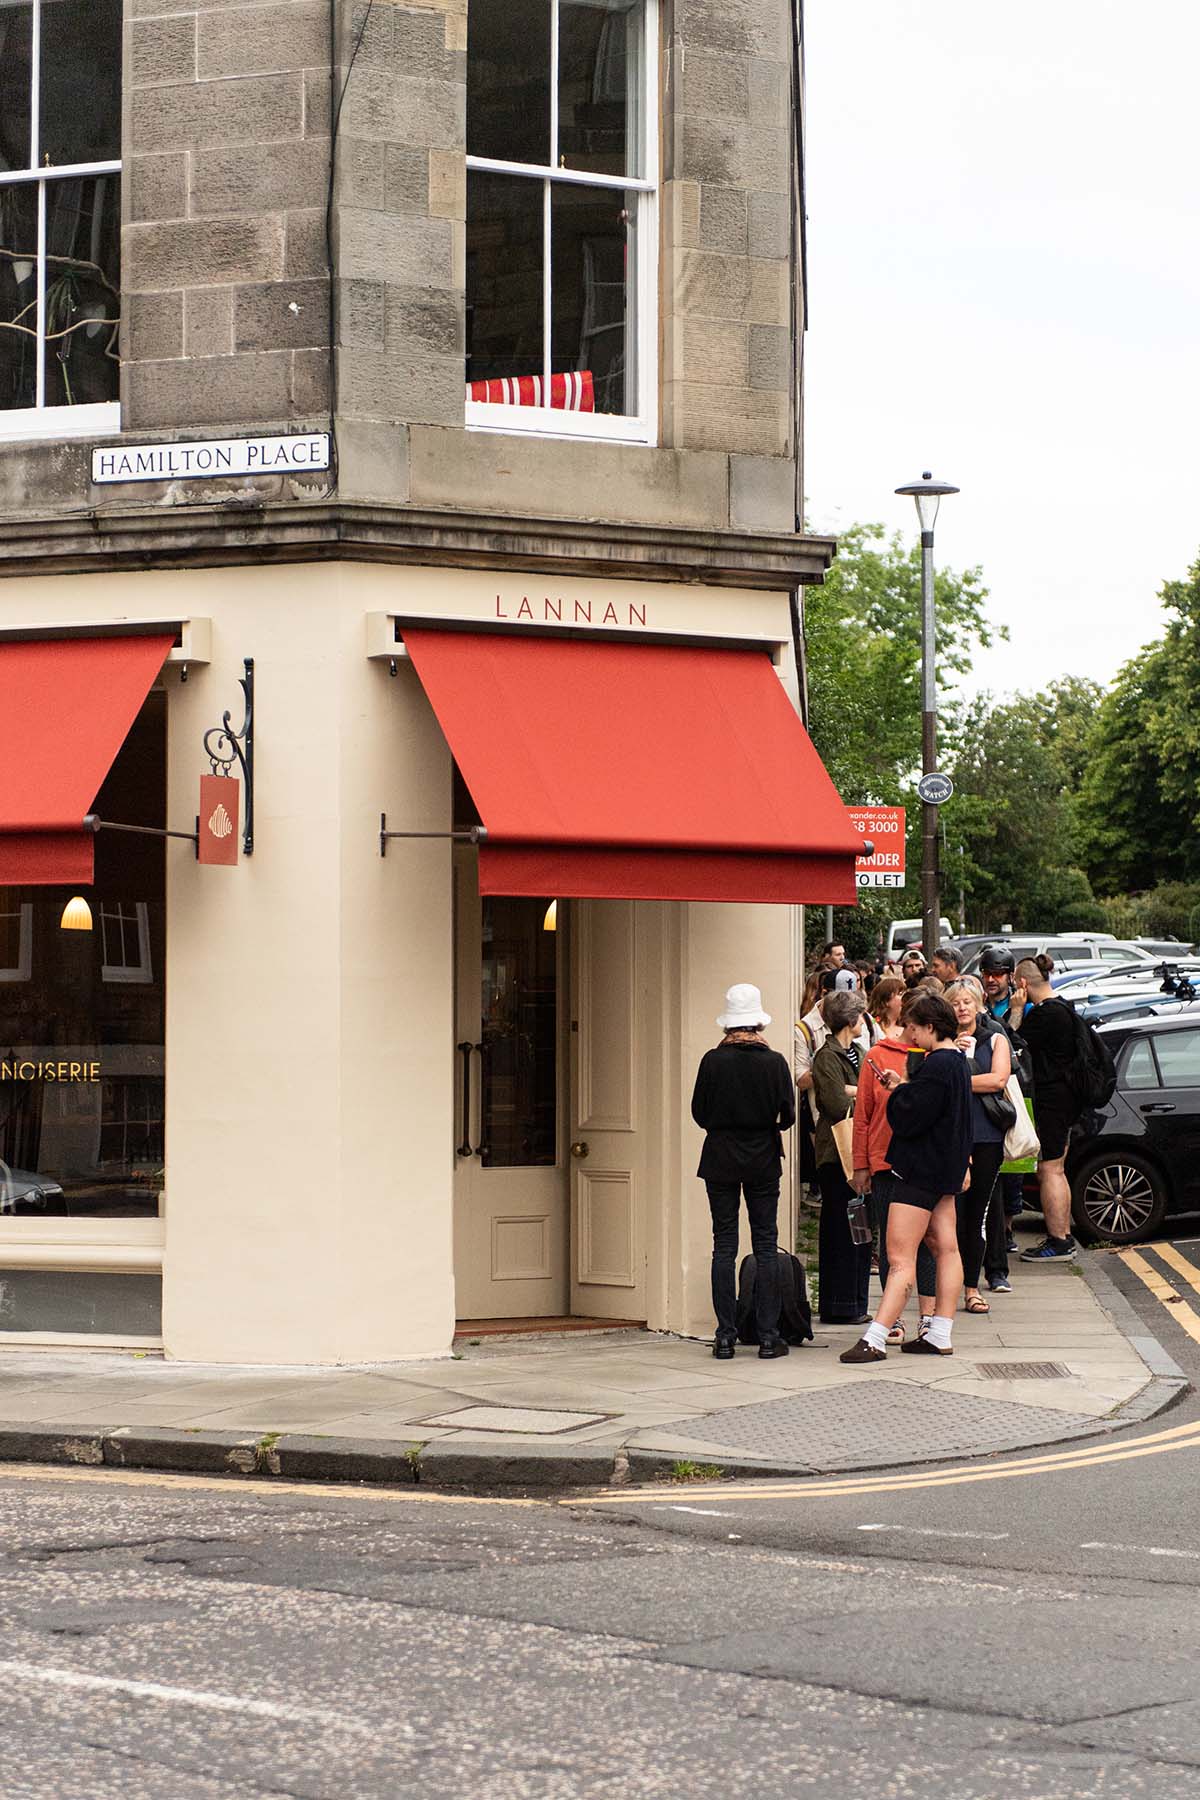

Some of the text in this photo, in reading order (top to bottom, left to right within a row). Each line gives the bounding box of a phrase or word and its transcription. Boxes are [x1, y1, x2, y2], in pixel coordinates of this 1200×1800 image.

[100, 441, 321, 475] HAMILTON PLACE
[496, 595, 646, 626] LANNAN
[924, 788, 949, 799] WATCH
[848, 812, 898, 820] xander.co.uk
[868, 821, 898, 833] 3000
[856, 852, 900, 866] ANDER
[856, 874, 901, 886] O LET
[1, 1062, 100, 1082] NOISERIE
